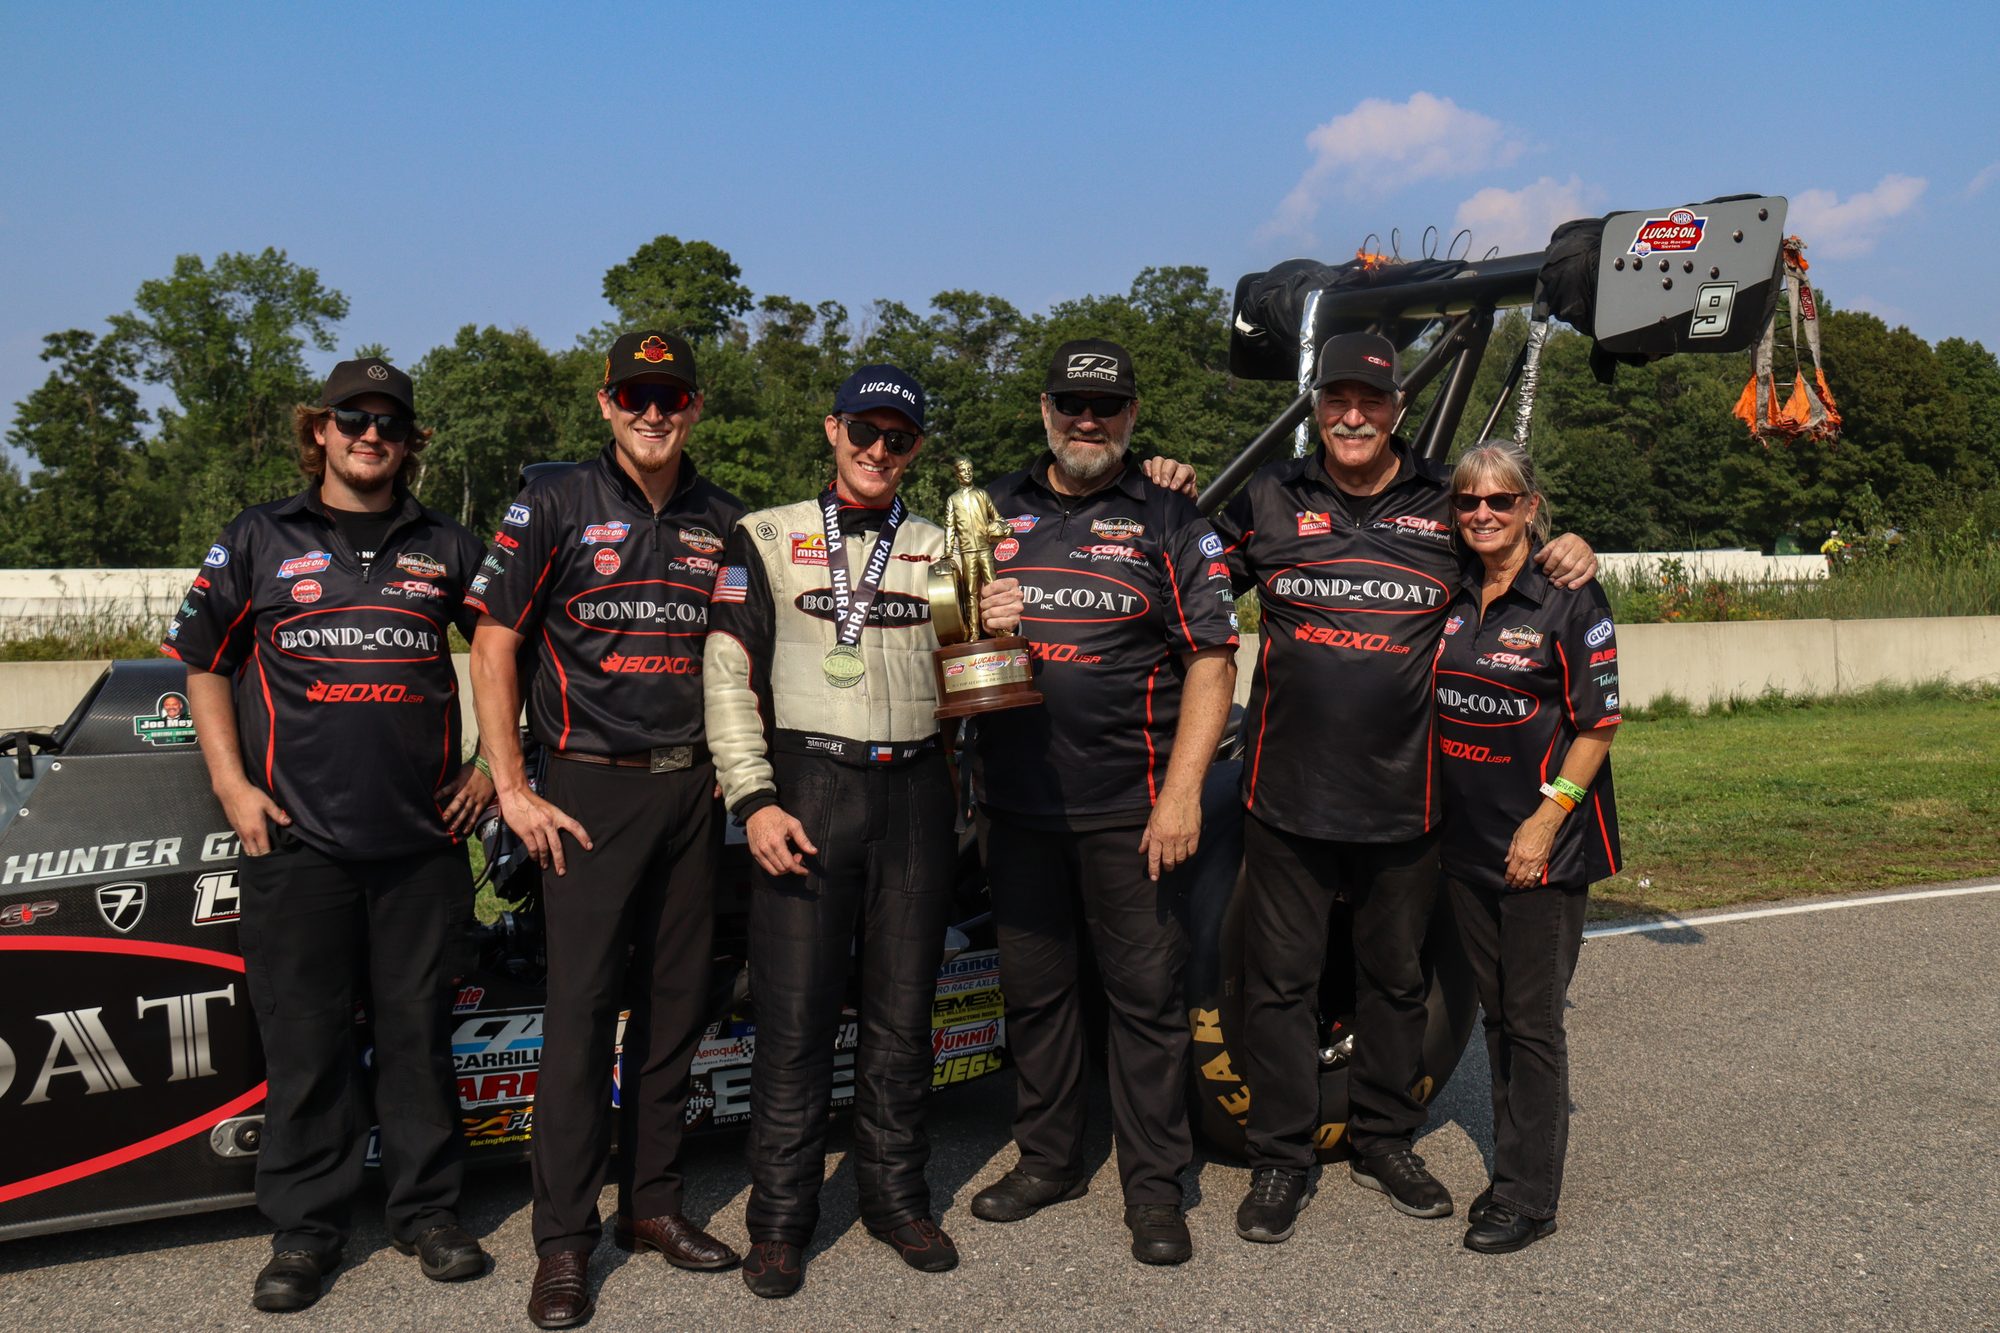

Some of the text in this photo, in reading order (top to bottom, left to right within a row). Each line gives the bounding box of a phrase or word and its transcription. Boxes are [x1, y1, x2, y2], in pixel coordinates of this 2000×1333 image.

[1642, 227, 1696, 239] LUCAS OIL
[1692, 284, 1735, 336] 9
[1067, 371, 1117, 382] CARRILLO
[860, 381, 916, 405] LUCAS OIL
[824, 504, 842, 553] NHRA
[1395, 515, 1439, 531] CGM
[1090, 545, 1135, 557] CGM
[284, 561, 311, 571] LUCAS
[686, 556, 719, 571] CGM
[864, 539, 891, 585] NHRA
[402, 581, 440, 596] CGM
[832, 569, 849, 622] NHRA
[1275, 578, 1441, 607] BOND-COAT
[278, 627, 439, 652] BOND-COAT
[1384, 645, 1412, 655] USA
[619, 655, 692, 674] BOXO
[1072, 654, 1102, 664] USA
[1491, 652, 1531, 667] CGM
[323, 684, 425, 703] BOXO USA
[141, 720, 165, 729] Joe
[1486, 755, 1512, 764] USA
[2, 837, 182, 885] HUNTER
[714, 1115, 739, 1125] BRAD
